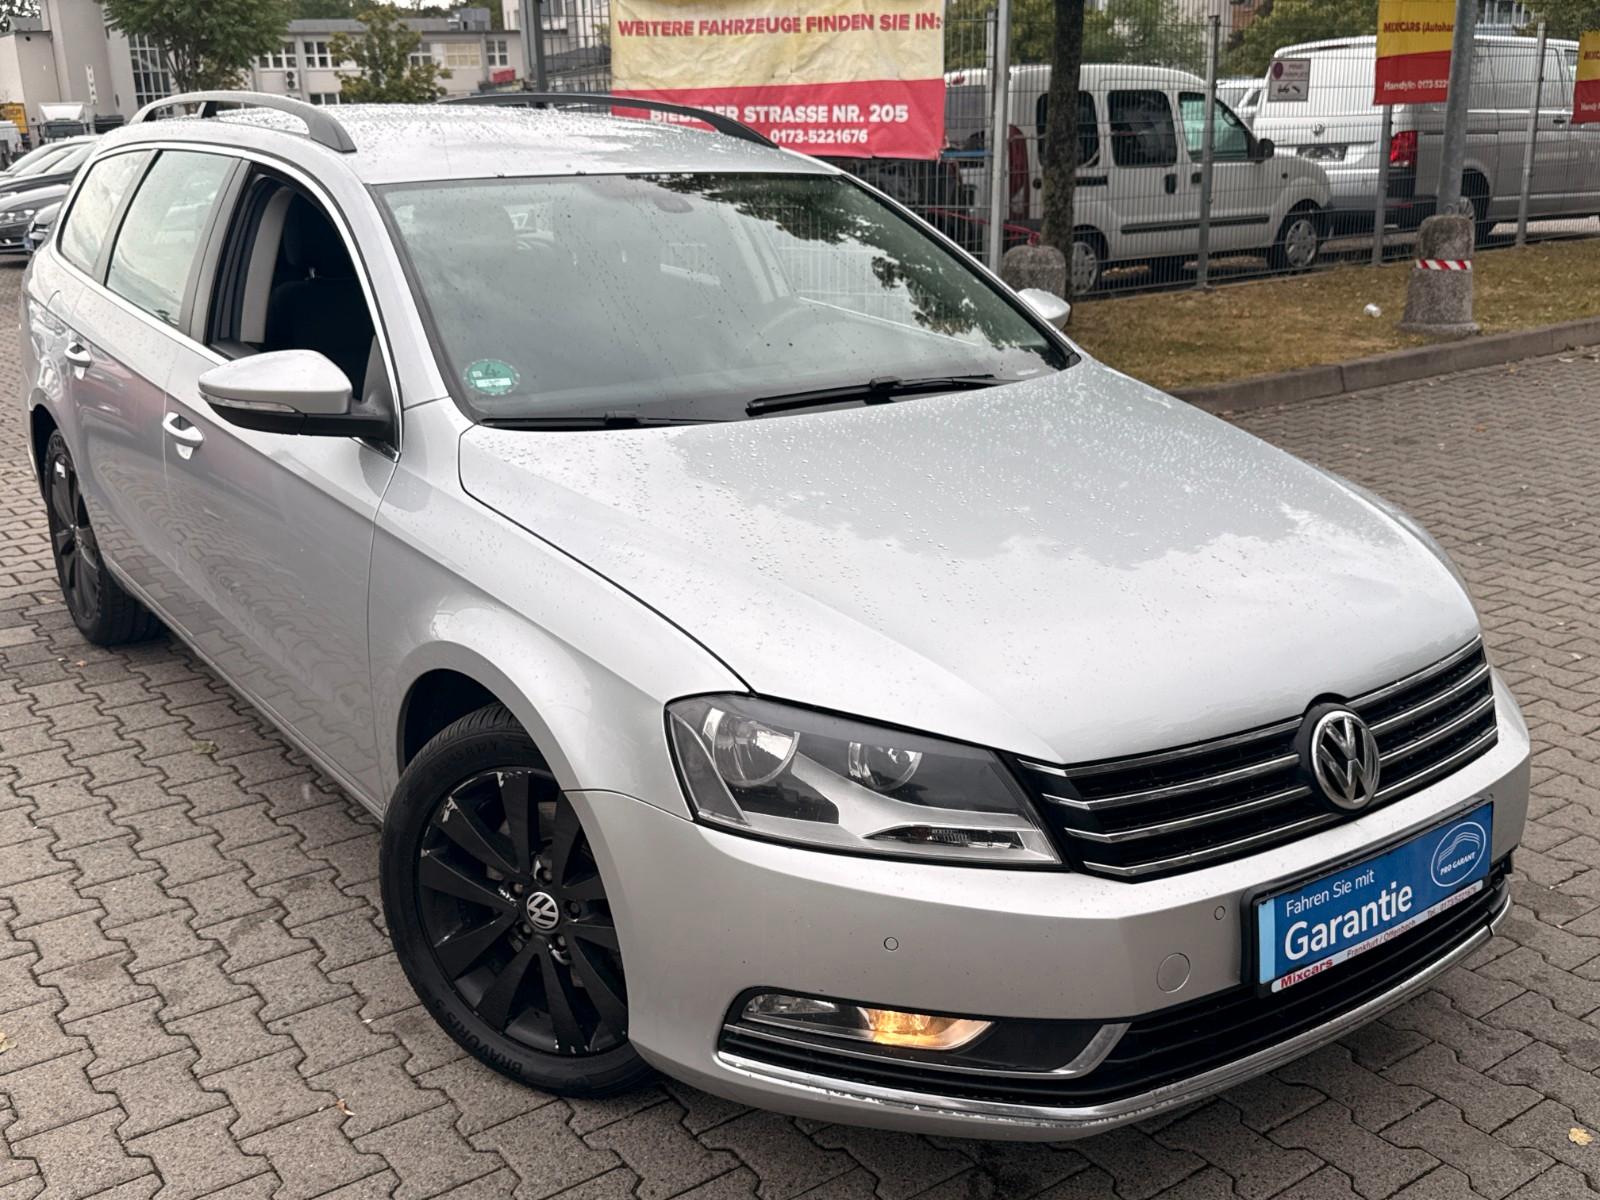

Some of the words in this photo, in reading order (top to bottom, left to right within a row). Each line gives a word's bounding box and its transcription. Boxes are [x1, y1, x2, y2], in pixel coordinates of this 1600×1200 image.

[618, 20, 694, 37] WEITERE
[699, 16, 801, 36] FAHRZEUGE
[806, 14, 874, 33] FINDEN
[879, 14, 910, 31] SIE
[915, 12, 942, 30] IN:
[743, 105, 829, 123] STRASSE
[832, 104, 865, 122] NR.
[868, 104, 909, 122] 205
[769, 129, 868, 144] 0173-5221676
[1440, 862, 1453, 876] PRO
[1452, 851, 1476, 869] GARANT
[1286, 890, 1330, 918] Fahren
[1332, 879, 1353, 899] Sie
[1355, 869, 1375, 890] mit
[1284, 881, 1413, 961] Garantie
[1280, 959, 1334, 989] Mixcars
[446, 1011, 523, 1074] BRAVURIS
